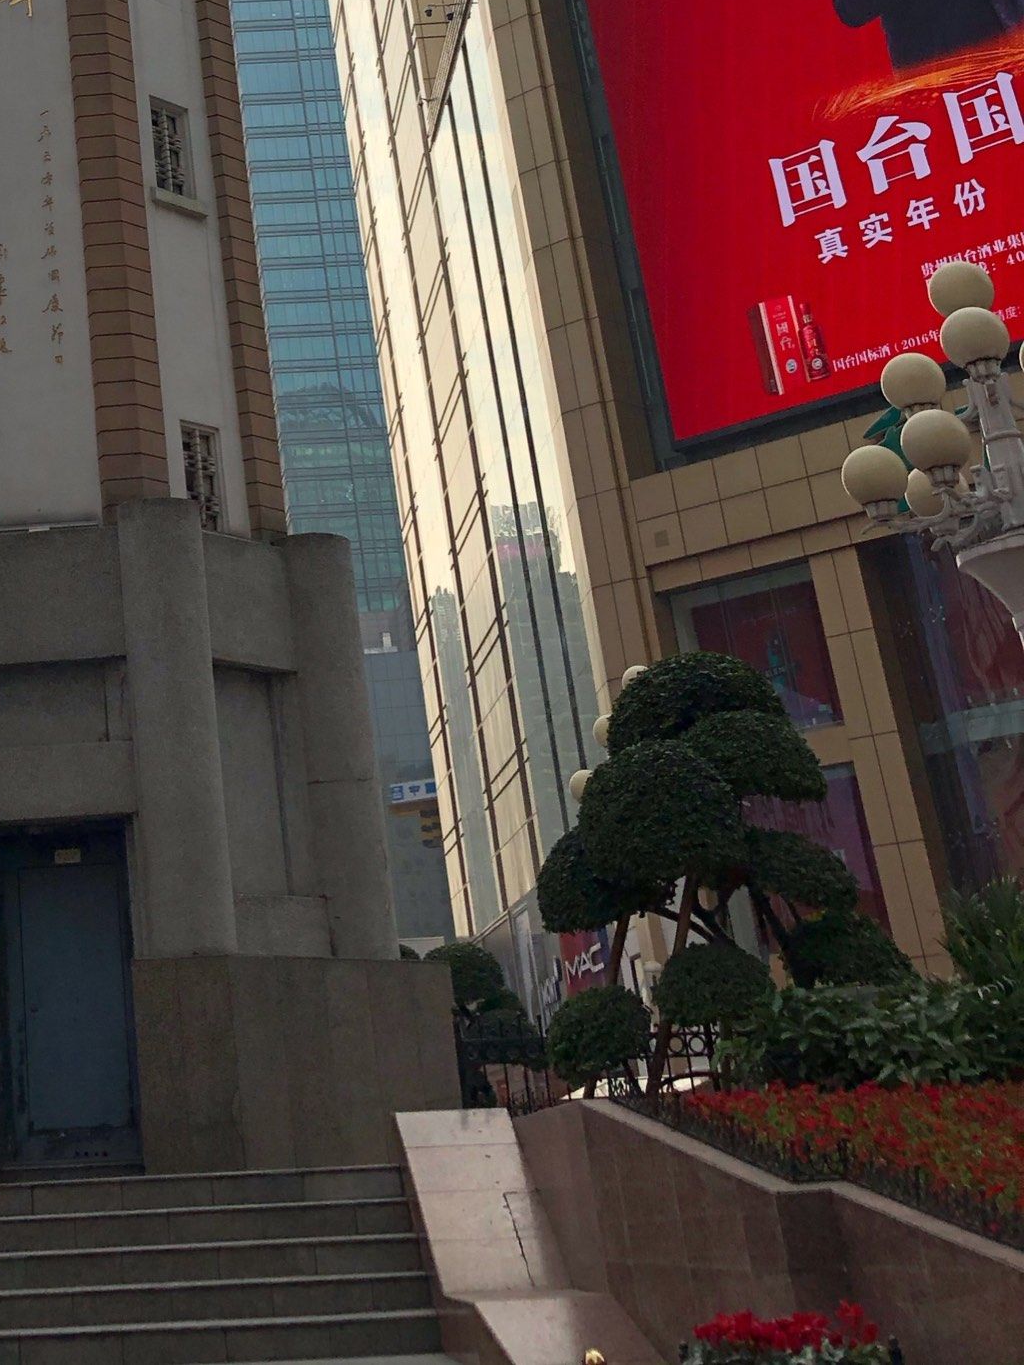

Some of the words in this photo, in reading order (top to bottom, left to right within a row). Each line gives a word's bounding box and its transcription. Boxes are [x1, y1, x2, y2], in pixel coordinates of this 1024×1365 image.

[768, 71, 1024, 228] 国台国
[814, 178, 986, 264] 真实年份
